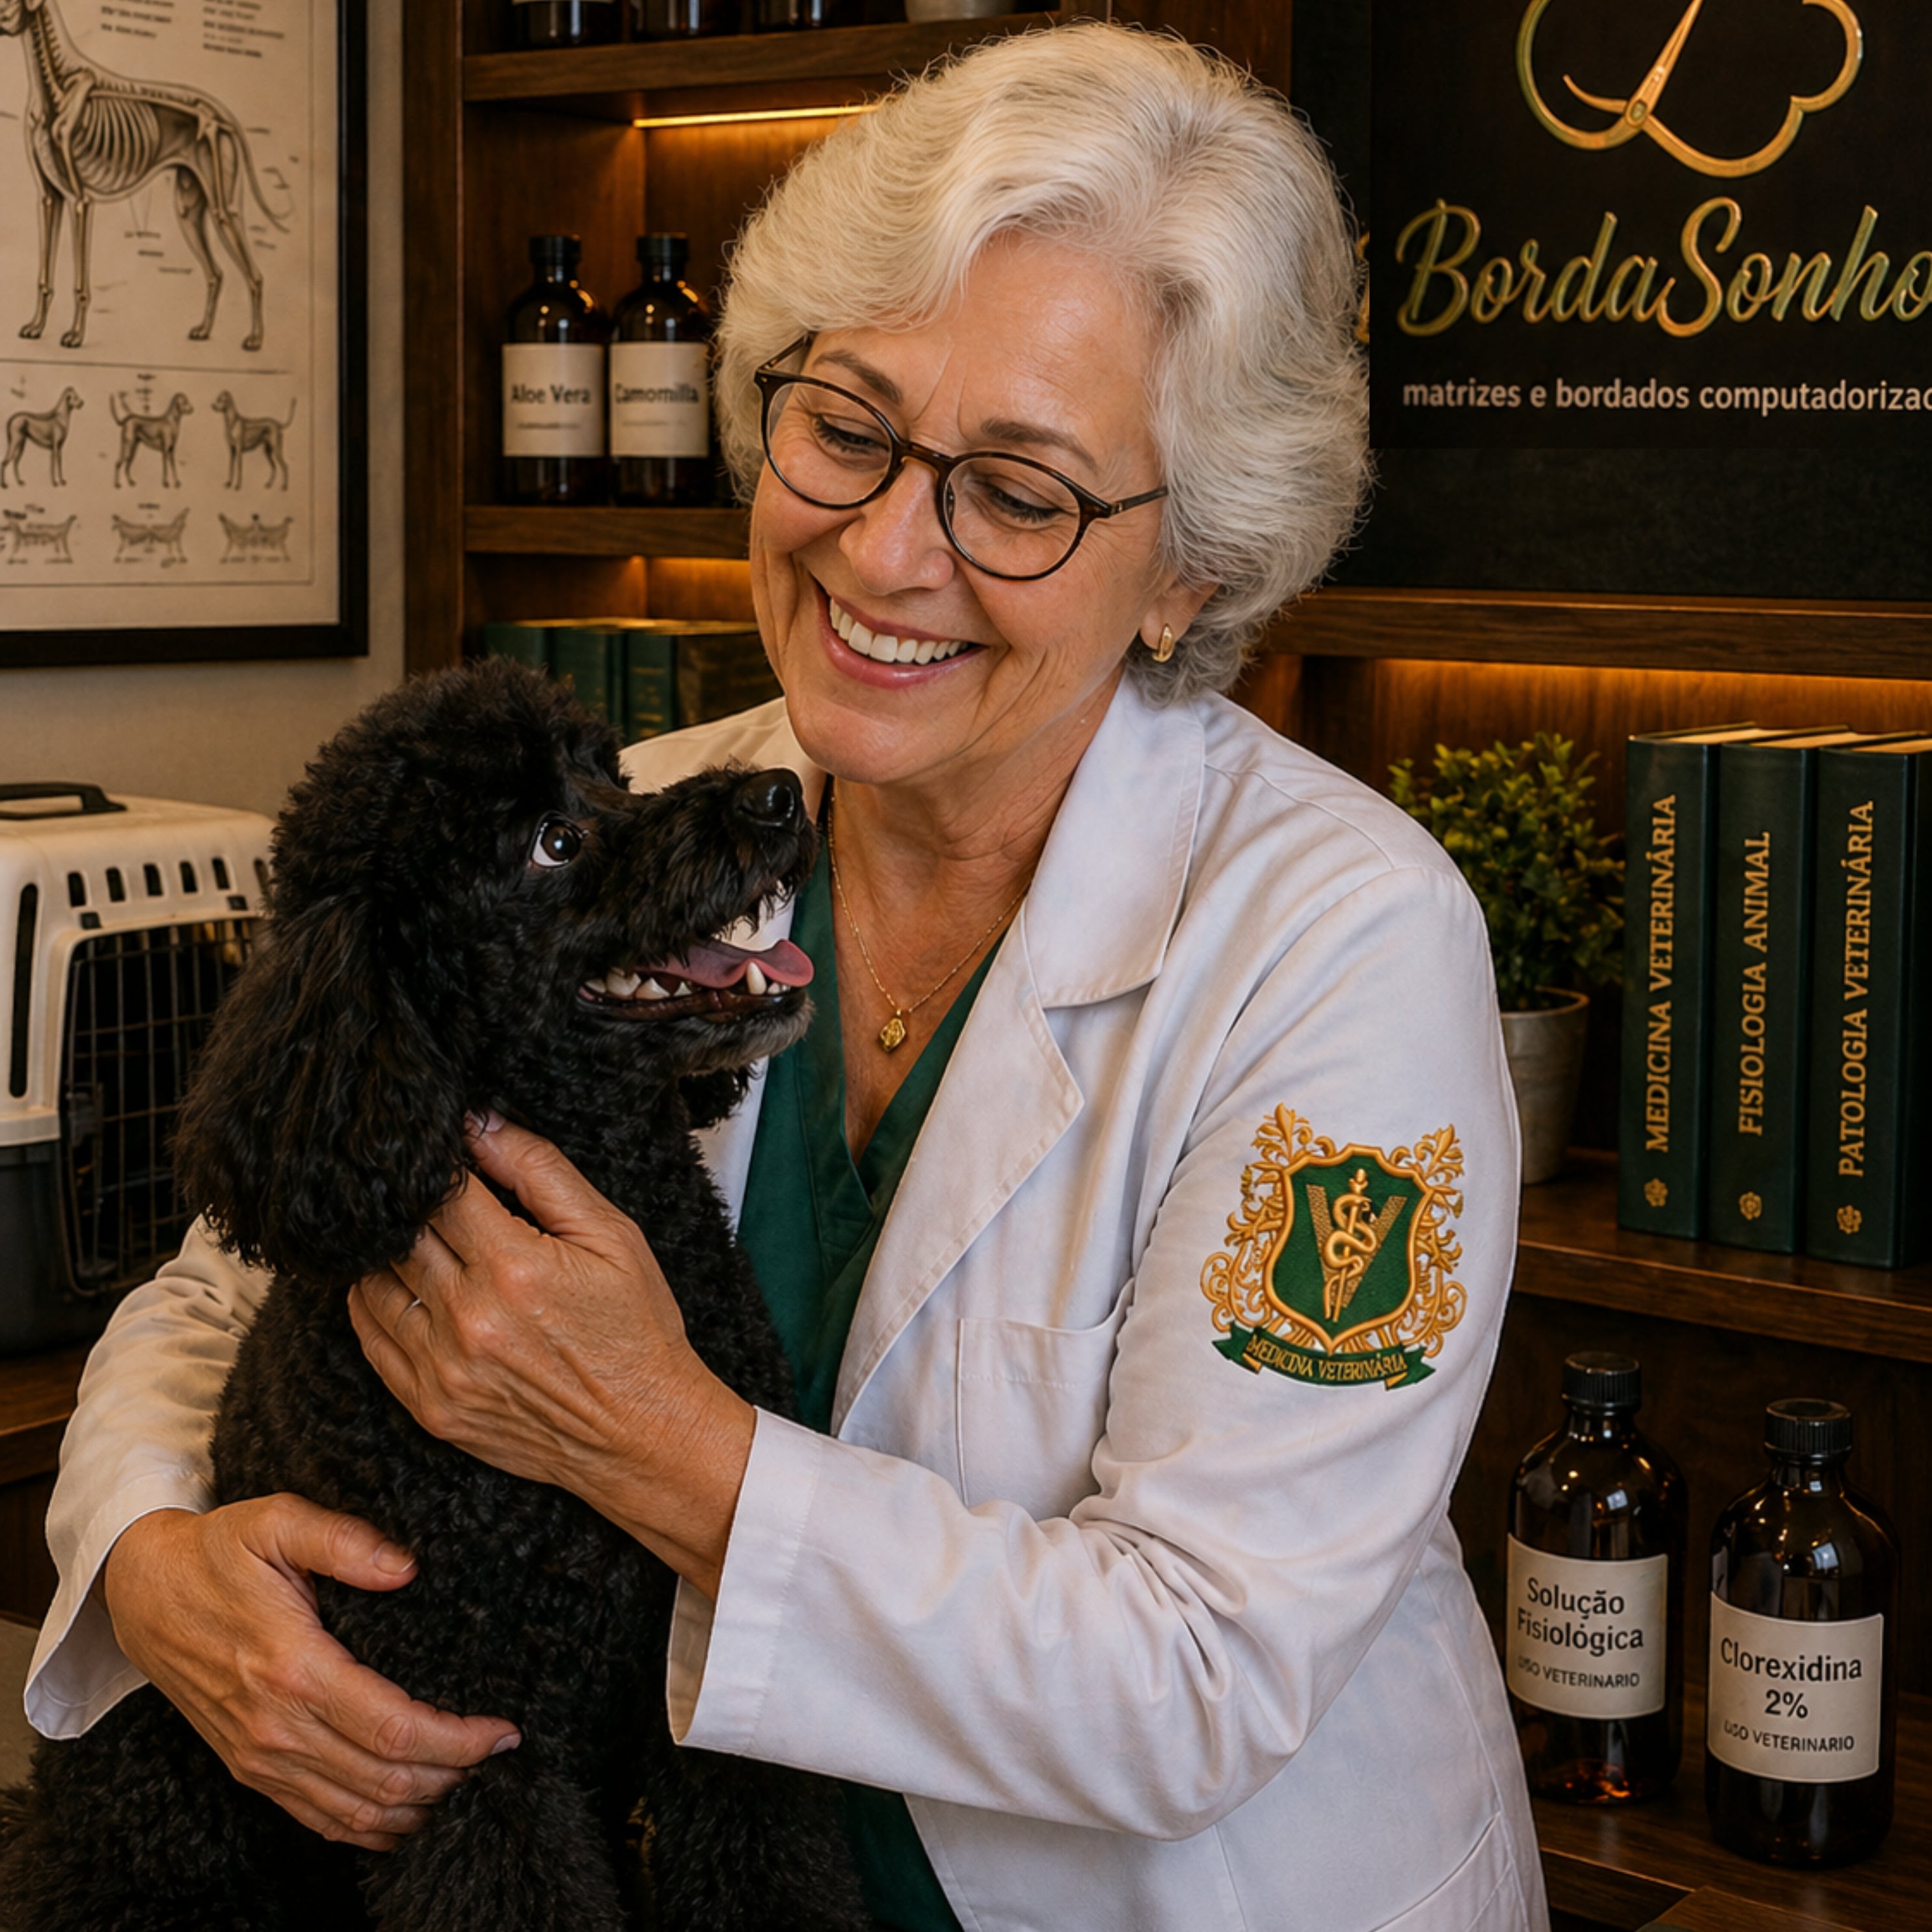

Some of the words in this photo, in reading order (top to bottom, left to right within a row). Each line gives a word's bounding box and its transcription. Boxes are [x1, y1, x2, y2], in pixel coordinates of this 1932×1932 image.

[1396, 196, 1932, 338] BordaSonho
[511, 384, 545, 404] Aloe
[550, 384, 591, 404] Vera
[1402, 377, 1521, 408] matrizes
[1530, 385, 1547, 407] e
[1556, 378, 1690, 409] bordados
[1646, 794, 1676, 992] VETERINÁRIA
[1743, 831, 1771, 953] ANIMAL
[1840, 801, 1875, 1000] VETERINÁRIA
[1738, 962, 1767, 1136] FISIOLOGIA
[1645, 1000, 1672, 1153] MEDICINA
[1838, 1008, 1868, 1177] PATOLOGIA
[1246, 1334, 1313, 1377] MEDICINA
[1318, 1352, 1407, 1380] VETERINÁRIA
[1527, 1577, 1625, 1620] Solução
[1518, 1607, 1643, 1657] Fisiológica
[1542, 1664, 1640, 1688] VETERINARIO
[1721, 1637, 1862, 1682] Clorexidina
[1765, 1689, 1808, 1719] 2%
[1752, 1728, 1855, 1752] VETERINARIO
